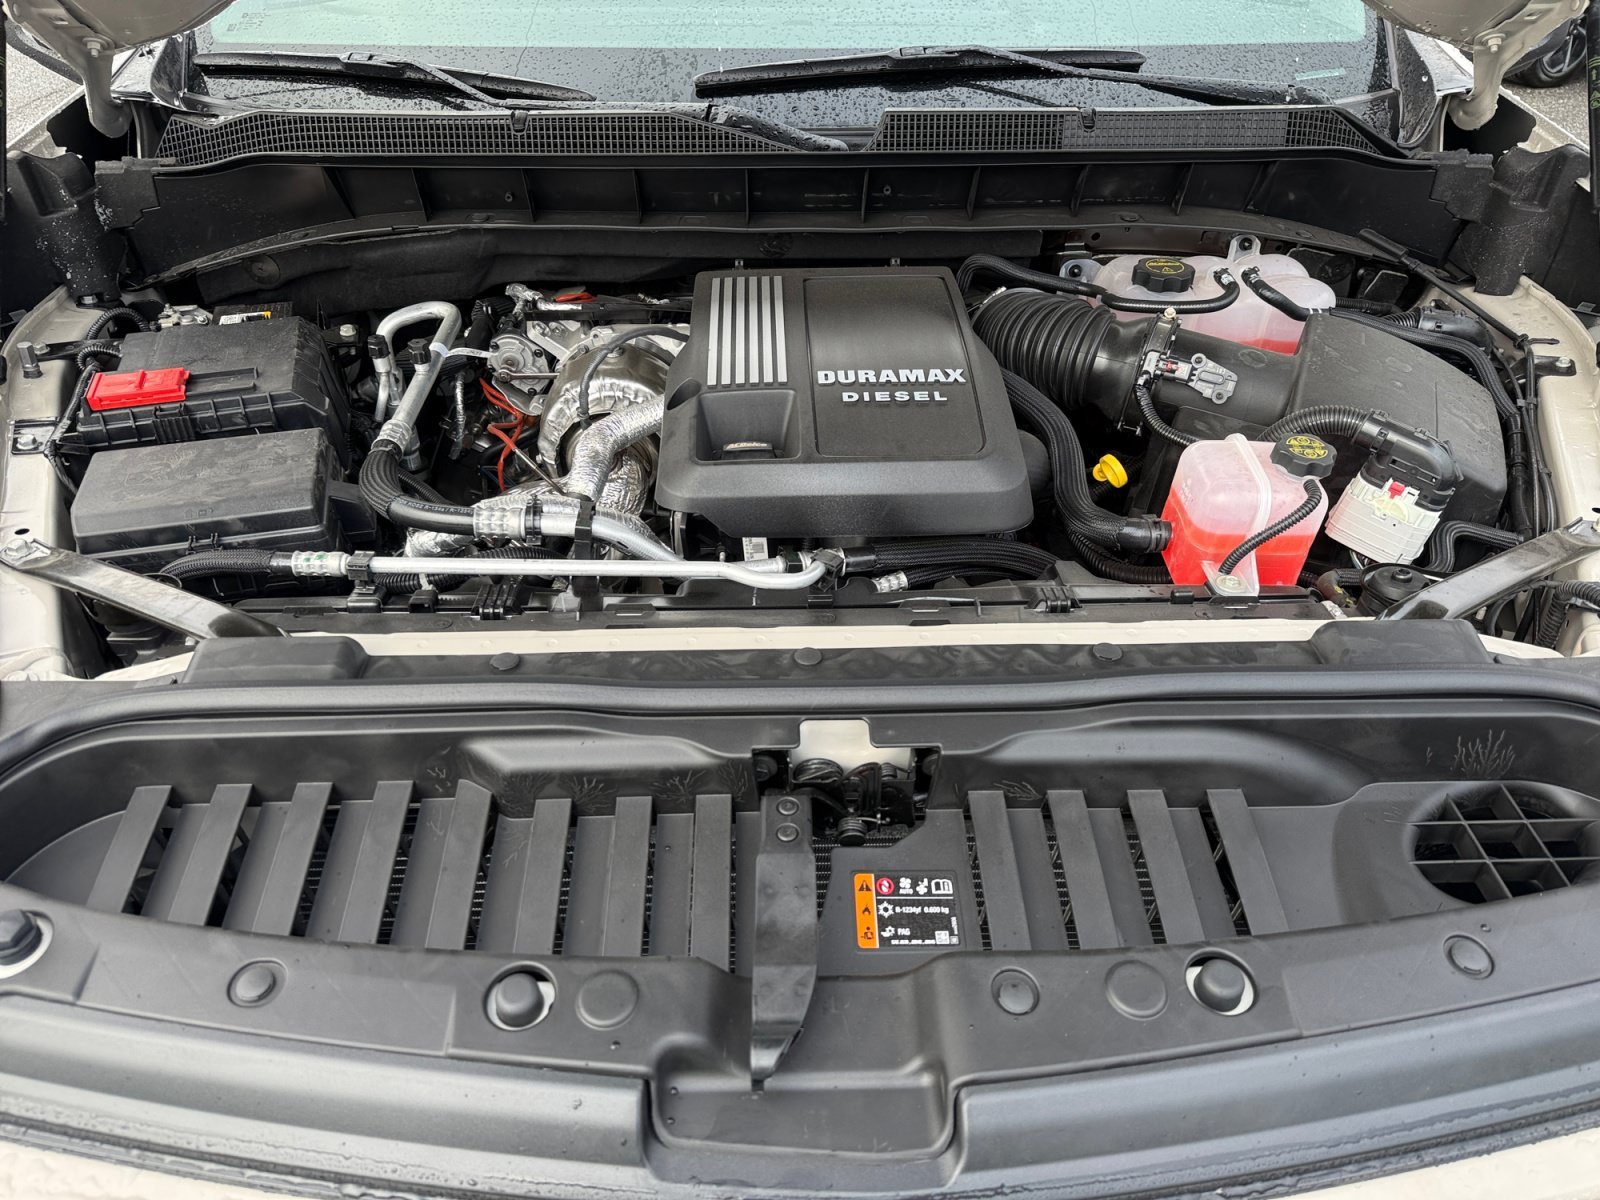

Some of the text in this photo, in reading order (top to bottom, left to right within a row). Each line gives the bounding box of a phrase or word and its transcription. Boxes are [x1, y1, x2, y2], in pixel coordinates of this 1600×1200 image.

[817, 369, 966, 384] DURAMAX
[842, 391, 948, 402] DIESEL
[895, 906, 921, 914] R-1234yf
[941, 906, 949, 914] kg
